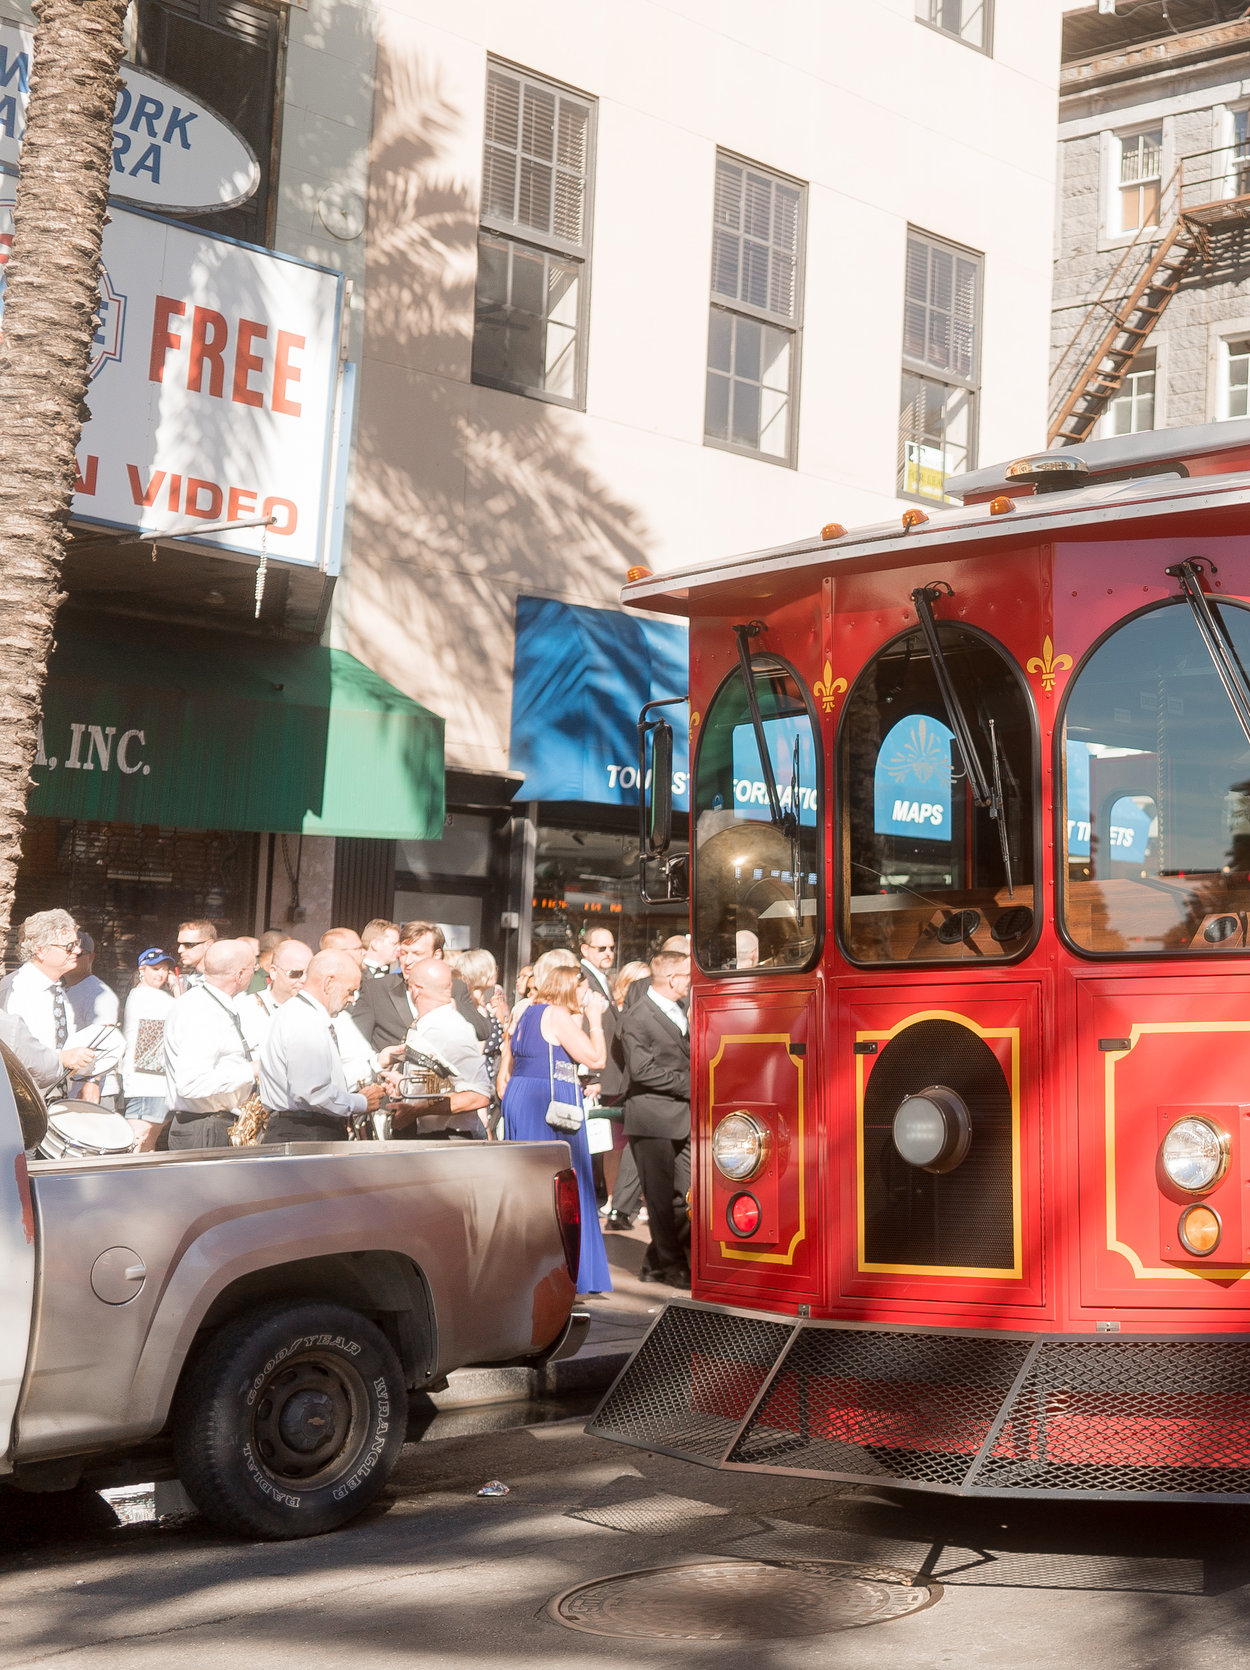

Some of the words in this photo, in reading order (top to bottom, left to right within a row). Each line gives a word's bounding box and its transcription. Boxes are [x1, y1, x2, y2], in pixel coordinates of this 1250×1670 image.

[113, 88, 198, 149] ORK
[148, 295, 305, 418] FREE
[127, 463, 298, 536] VIDEO
[65, 722, 151, 776] INC.
[892, 799, 943, 826] MAPS
[333, 1376, 390, 1501] WRANGLER
[243, 1442, 301, 1508] RADIAL
